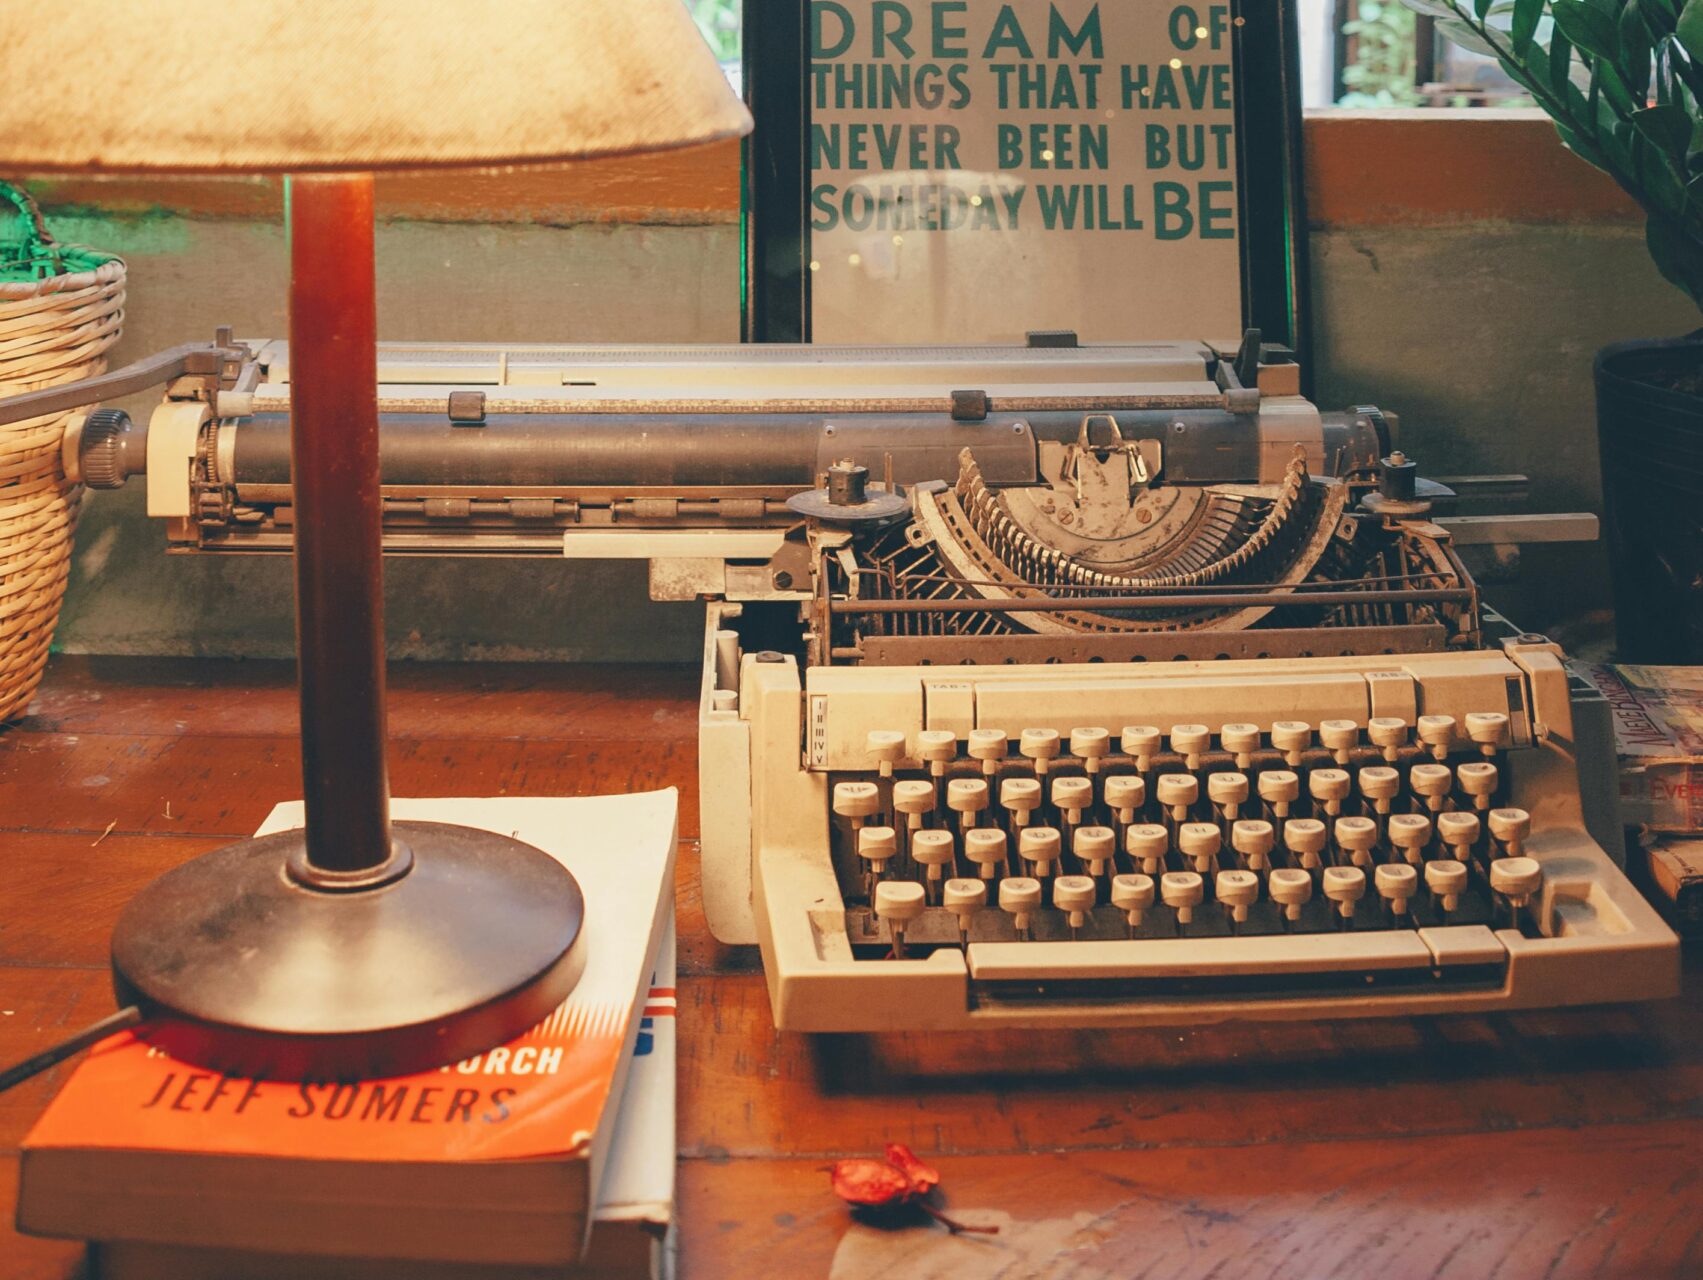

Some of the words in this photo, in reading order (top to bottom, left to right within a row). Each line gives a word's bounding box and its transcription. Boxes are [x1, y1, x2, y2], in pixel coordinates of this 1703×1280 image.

[811, 0, 1104, 60] DREAM
[1168, 5, 1228, 51] OF
[811, 63, 971, 110] THINGS
[989, 64, 1102, 110] THAT
[1121, 64, 1232, 110] HAVE
[811, 124, 961, 170] NEVER
[997, 124, 1108, 170] BEEN
[1145, 124, 1233, 171] BUT
[811, 183, 1026, 232] SOMEDAY
[1036, 184, 1143, 230] WILL
[1153, 181, 1235, 240] BE
[815, 728, 825, 737] III
[817, 715, 823, 723] II
[814, 742, 825, 751] IV
[816, 755, 823, 764] V
[440, 1046, 563, 1074] URCH
[142, 1072, 263, 1115] JEFF
[288, 1083, 519, 1124] SOMERS
